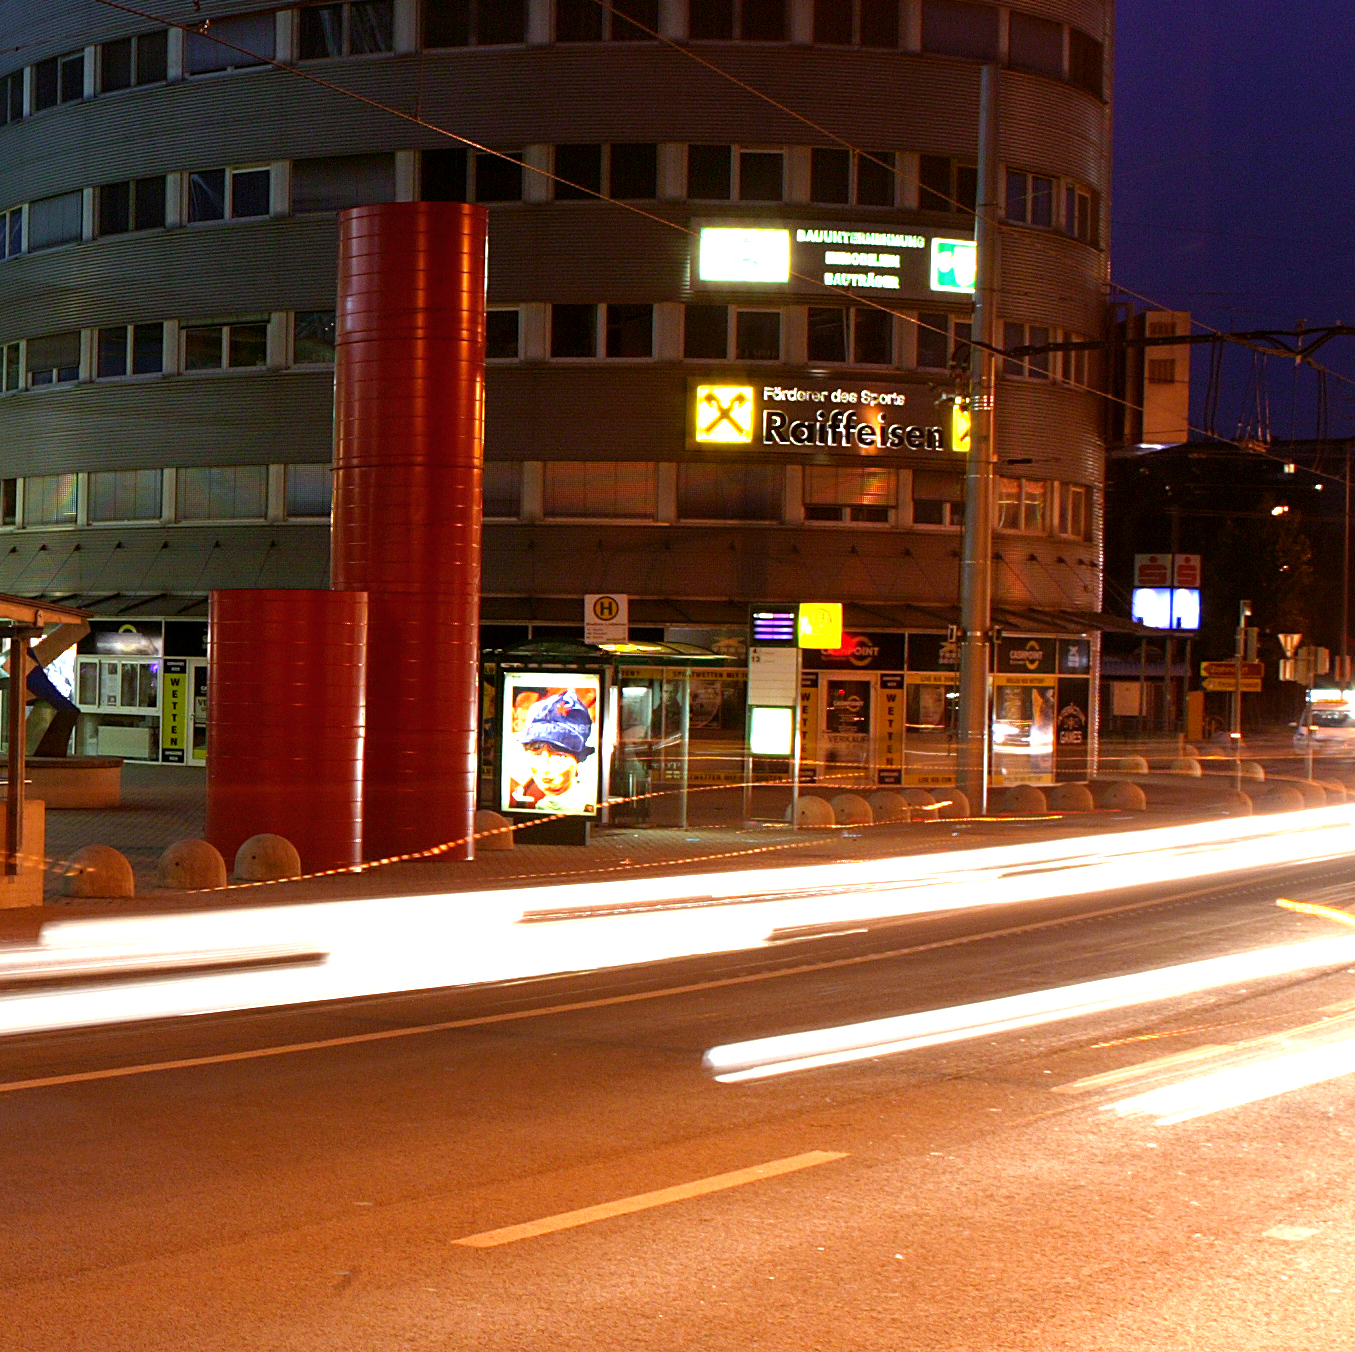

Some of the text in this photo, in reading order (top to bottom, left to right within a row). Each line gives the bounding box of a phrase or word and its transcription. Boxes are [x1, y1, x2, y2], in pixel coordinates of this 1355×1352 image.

[796, 228, 926, 249] BAUUNTERNEHMUNG
[824, 250, 901, 269] IMMOBILIEN
[823, 271, 901, 290] BAUTRÄGER
[763, 386, 907, 407] Förderer des Sports
[762, 408, 945, 452] Raiffeisen
[600, 601, 613, 616] H
[170, 678, 181, 746] WETTEN
[886, 693, 897, 765] WETTEN
